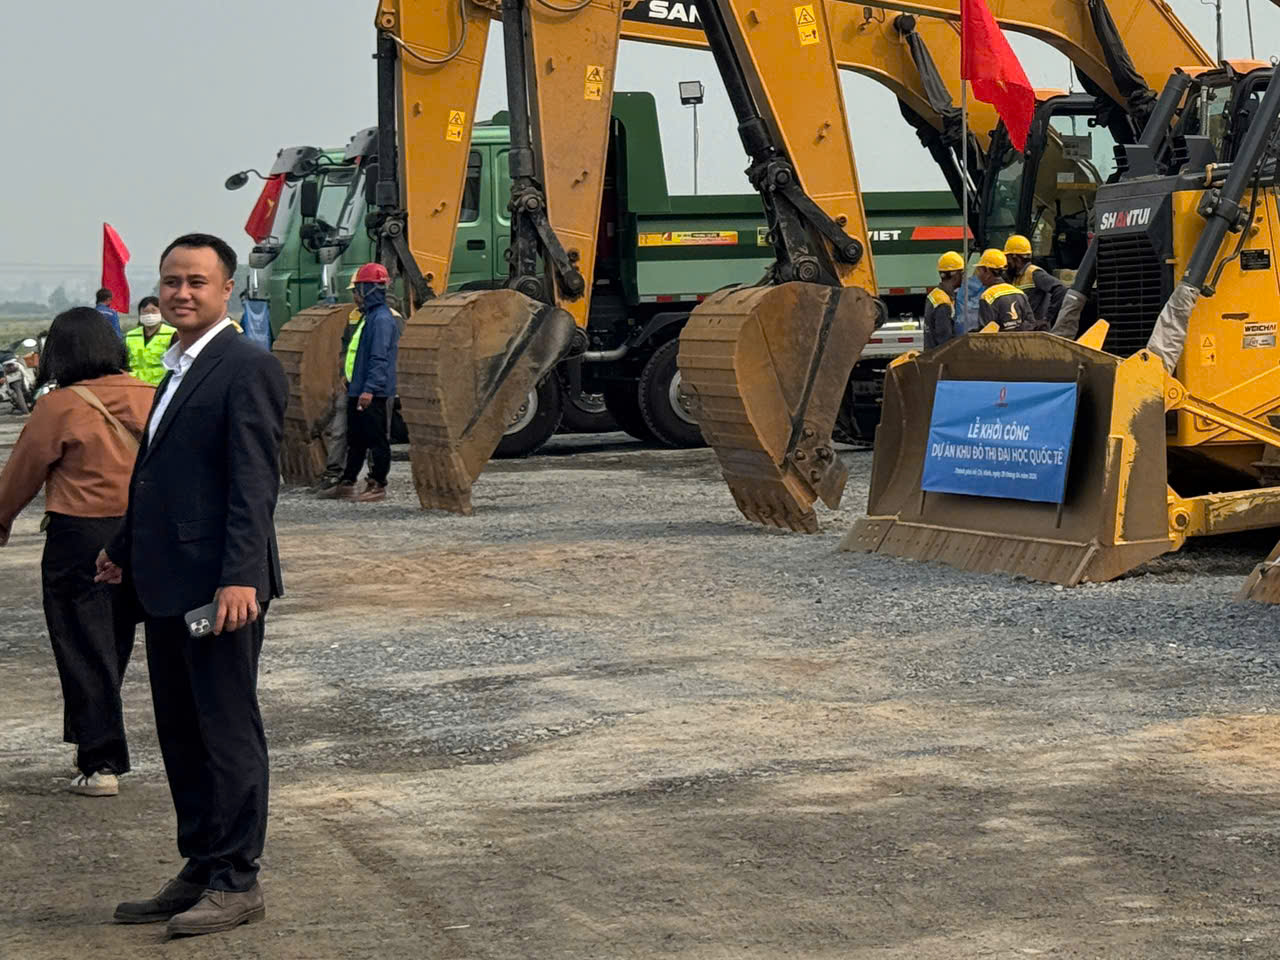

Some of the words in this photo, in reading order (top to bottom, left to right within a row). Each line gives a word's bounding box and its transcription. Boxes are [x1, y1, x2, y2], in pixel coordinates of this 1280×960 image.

[1100, 207, 1150, 230] SHANTUI
[1244, 324, 1276, 332] WEICHAI
[967, 416, 980, 439] LỄ
[980, 418, 1001, 440] KHỞI
[1004, 421, 1030, 441] CÔNG
[931, 443, 944, 461] DỰ
[944, 442, 955, 459] ÁN
[956, 446, 971, 459] KHU
[972, 443, 984, 460] ĐÔ
[985, 447, 997, 464] THỊ
[998, 447, 1011, 465] ĐẠI
[1012, 449, 1028, 465] HỌC
[1030, 444, 1051, 465] QUỐC
[1052, 445, 1065, 465] TẾ
